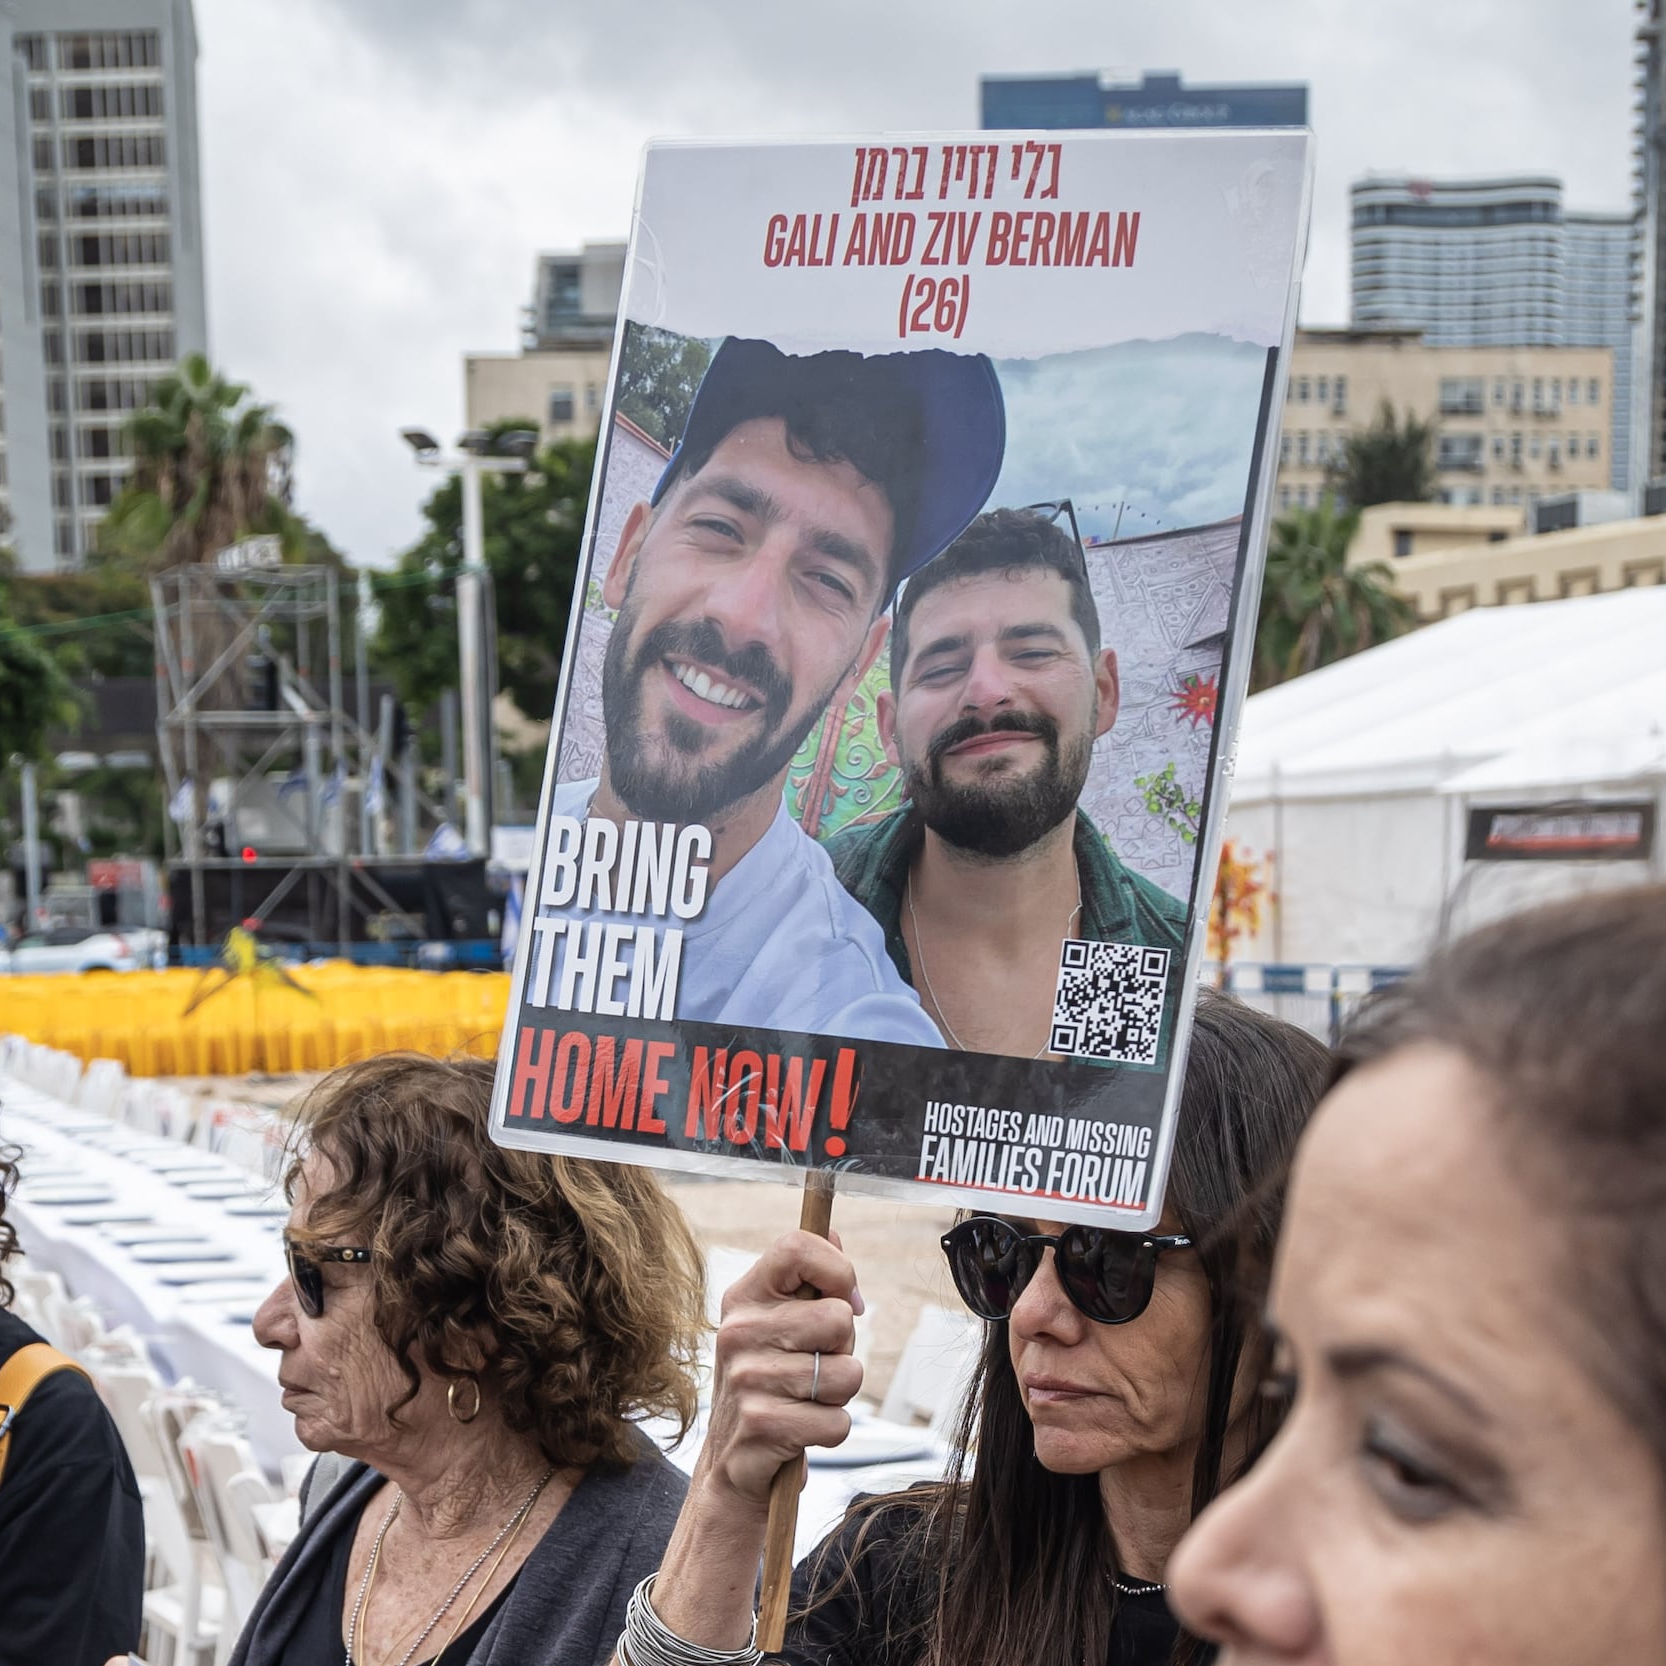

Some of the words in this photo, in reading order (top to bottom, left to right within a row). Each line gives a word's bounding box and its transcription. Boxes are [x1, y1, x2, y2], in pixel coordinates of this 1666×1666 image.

[850, 146, 929, 208] ברמן
[938, 145, 999, 200] וזיו
[1011, 140, 1062, 200] גלי
[763, 213, 840, 267] GALI
[843, 212, 916, 266] AND
[920, 211, 982, 266] ZIV
[985, 211, 1140, 267] BERMAN
[898, 274, 970, 338] (26)
[541, 815, 712, 919] BRING
[531, 916, 683, 1022] THEM
[509, 1027, 675, 1135] HOME
[684, 1046, 857, 1158] NOW!
[923, 1101, 1023, 1143] HOSTAGES
[1023, 1113, 1064, 1149] AND
[1065, 1118, 1152, 1159] MISSING
[918, 1134, 1042, 1193] FAMILIES
[1044, 1150, 1147, 1207] FORUM
